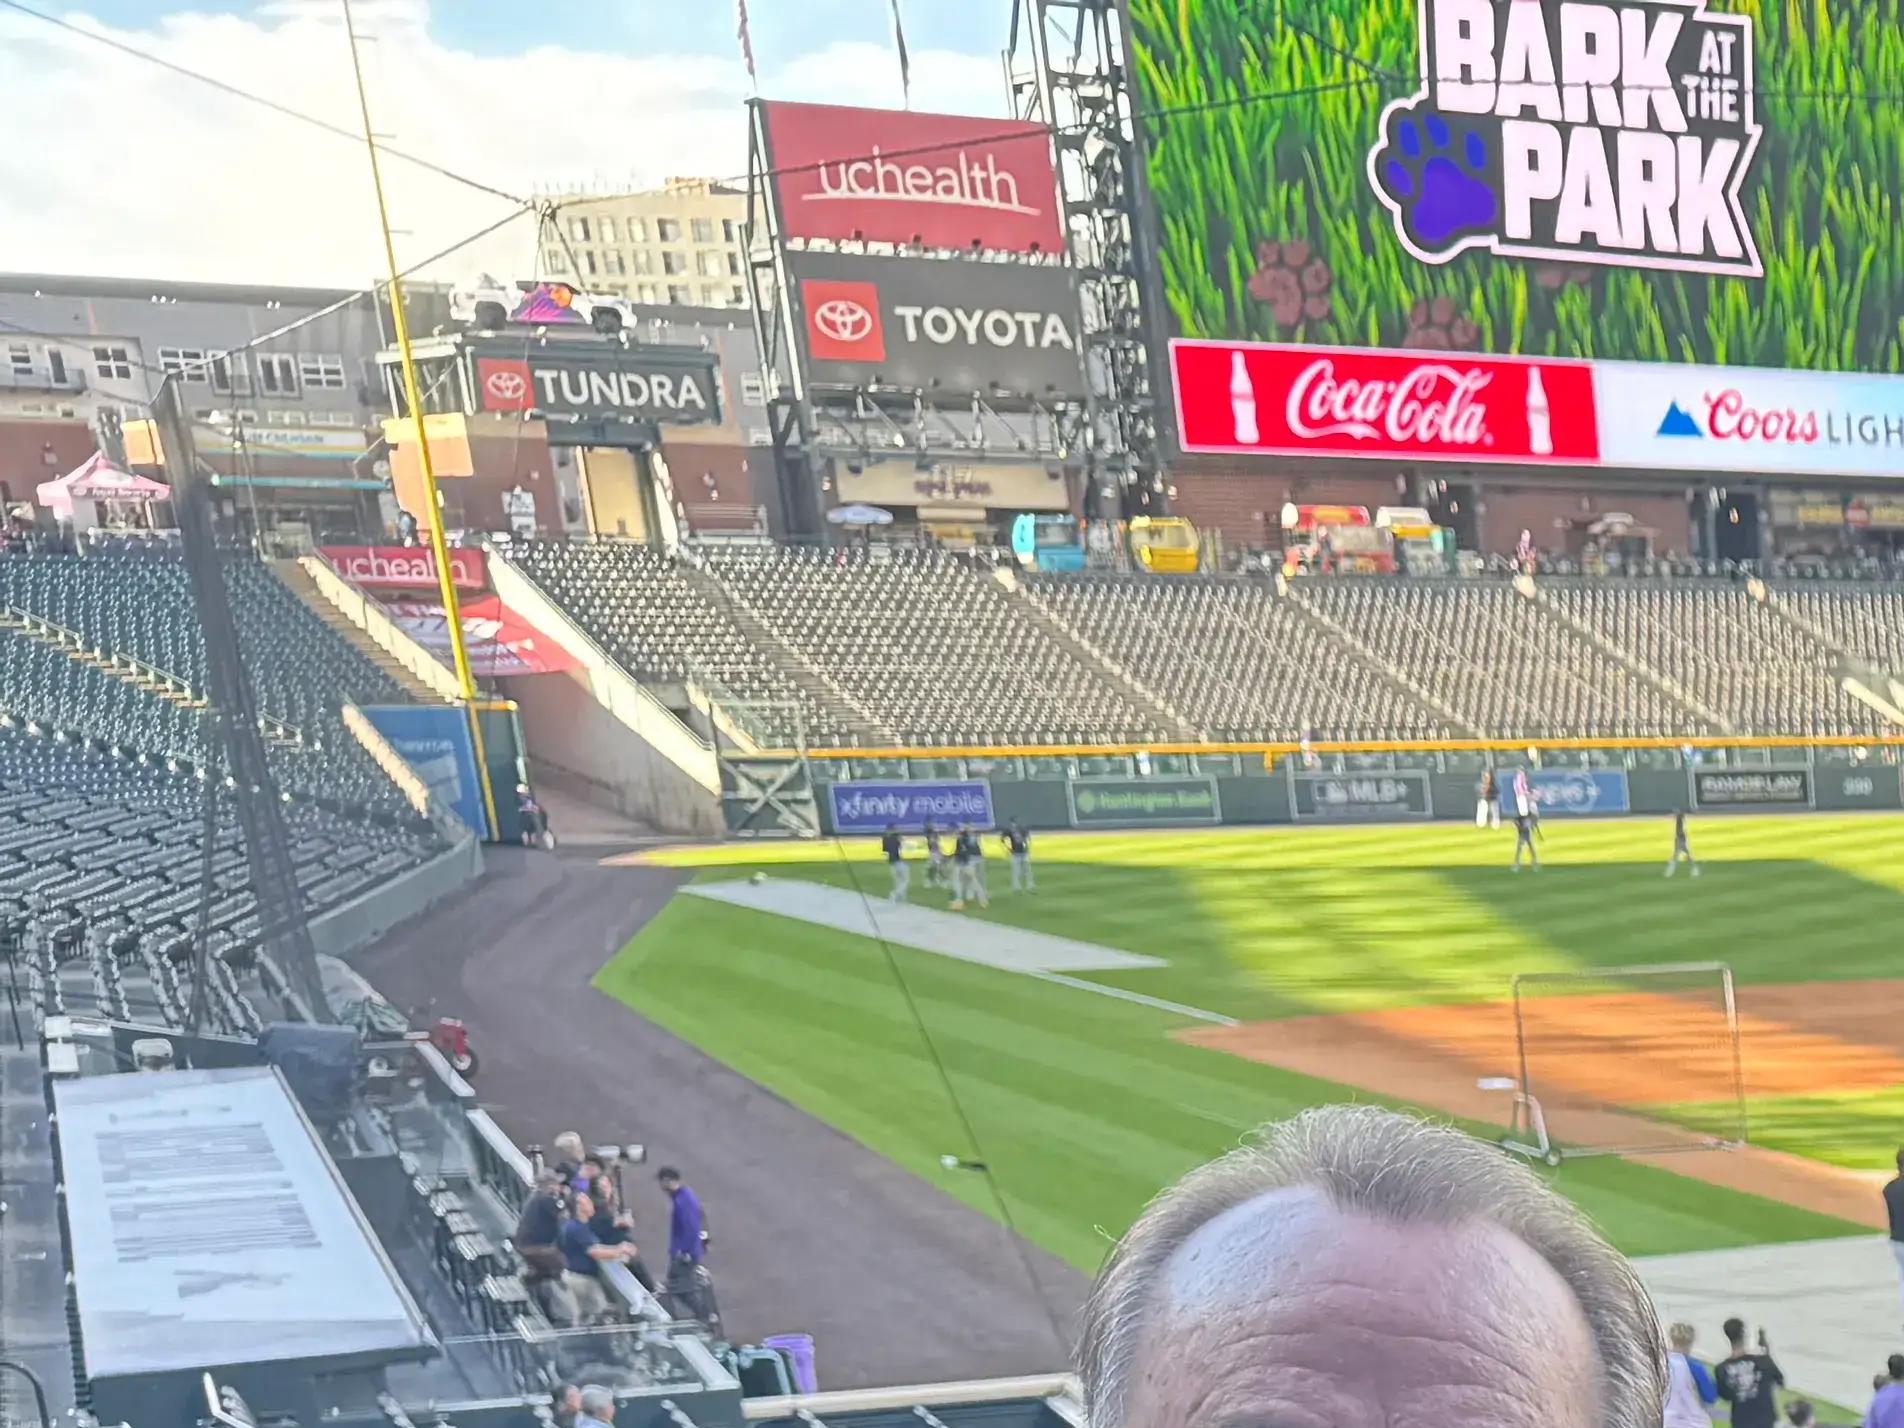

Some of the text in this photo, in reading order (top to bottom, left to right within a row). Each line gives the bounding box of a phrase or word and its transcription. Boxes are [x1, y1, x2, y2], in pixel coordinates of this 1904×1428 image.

[1434, 0, 1687, 132] BARK
[1699, 30, 1737, 74] AT
[1681, 75, 1740, 122] THE
[818, 145, 1021, 207] uchealth
[1501, 118, 1744, 258] PARK
[894, 305, 1074, 351] TOYOTA
[534, 369, 706, 409] TUNDRA
[1704, 387, 1819, 443] Coors
[340, 549, 467, 584] uchealh
